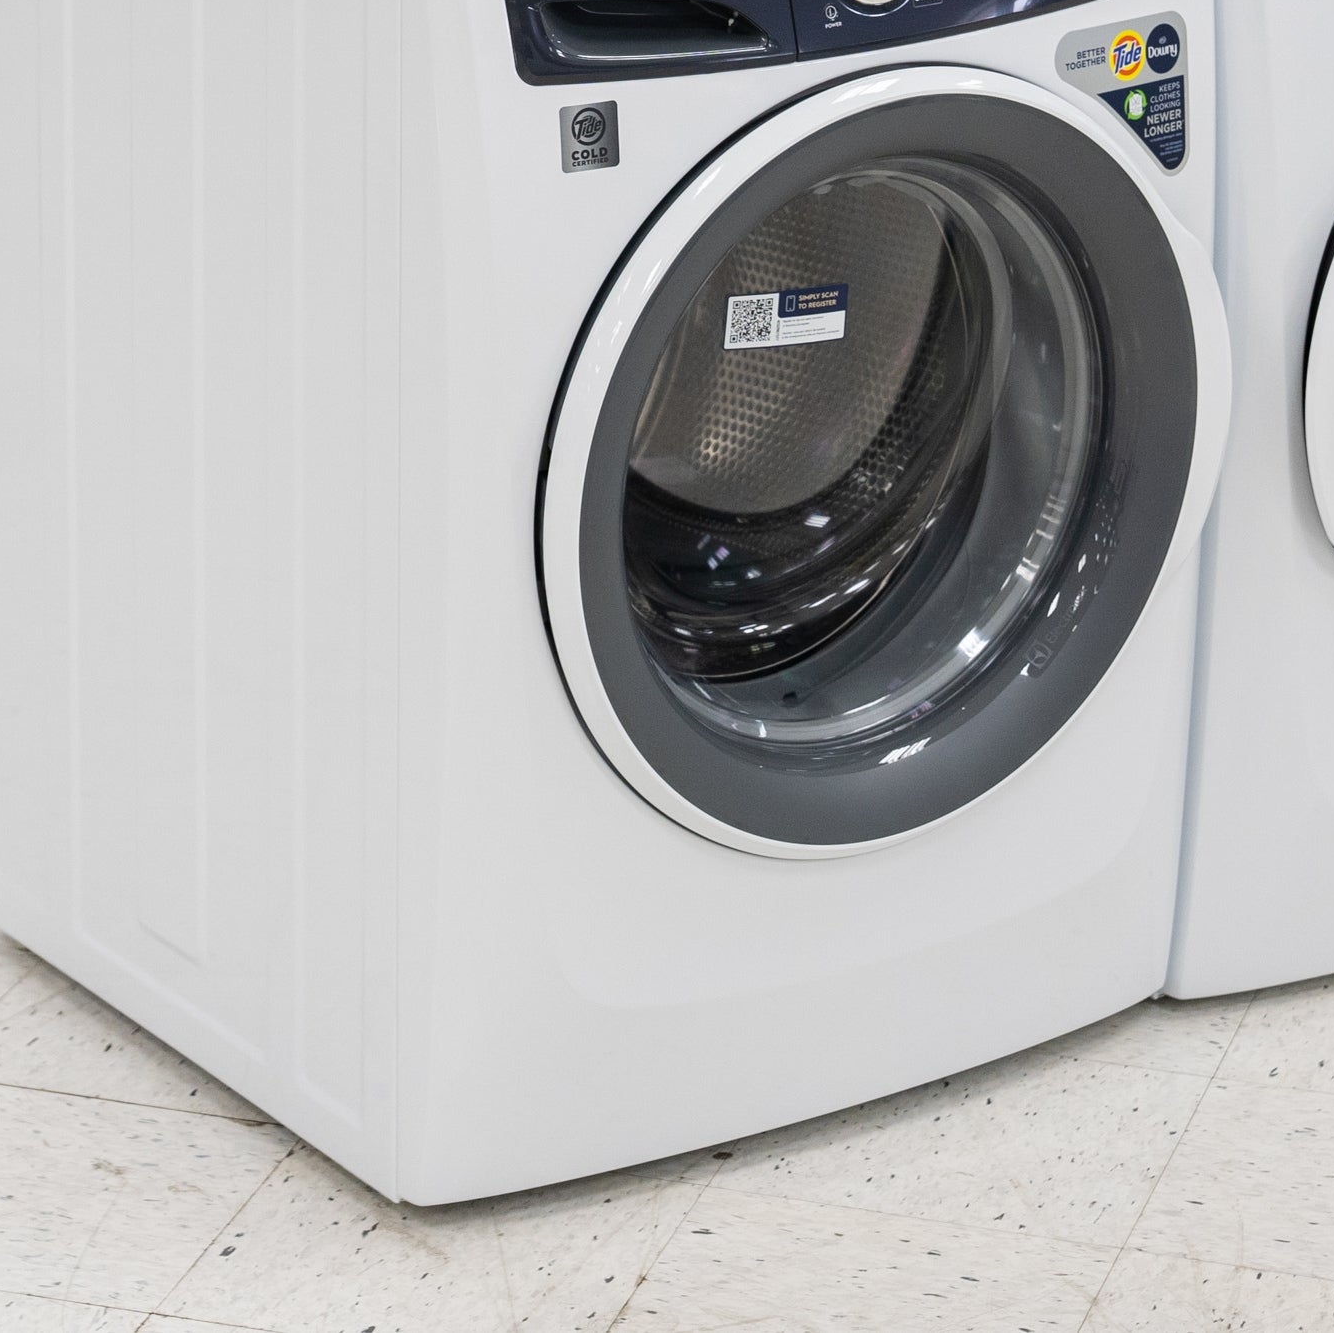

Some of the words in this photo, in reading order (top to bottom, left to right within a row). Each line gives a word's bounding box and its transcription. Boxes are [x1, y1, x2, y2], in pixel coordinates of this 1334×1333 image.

[1077, 47, 1106, 60] BETTER
[1113, 39, 1142, 75] Tide
[1148, 44, 1178, 59] Downy
[1065, 56, 1106, 71] TOGETHER
[1159, 81, 1180, 93] KEEPS
[1150, 90, 1181, 104] CLOTHES
[1150, 99, 1181, 113] LOOKING
[1147, 108, 1182, 126] NEWER
[575, 114, 602, 140] Tide
[1144, 121, 1183, 138] LONGER
[571, 147, 607, 161] COLD
[572, 157, 609, 167] CERTIFIED
[798, 292, 821, 301] SIMPLY
[798, 302, 807, 310] TO
[808, 299, 837, 308] REGISTER
